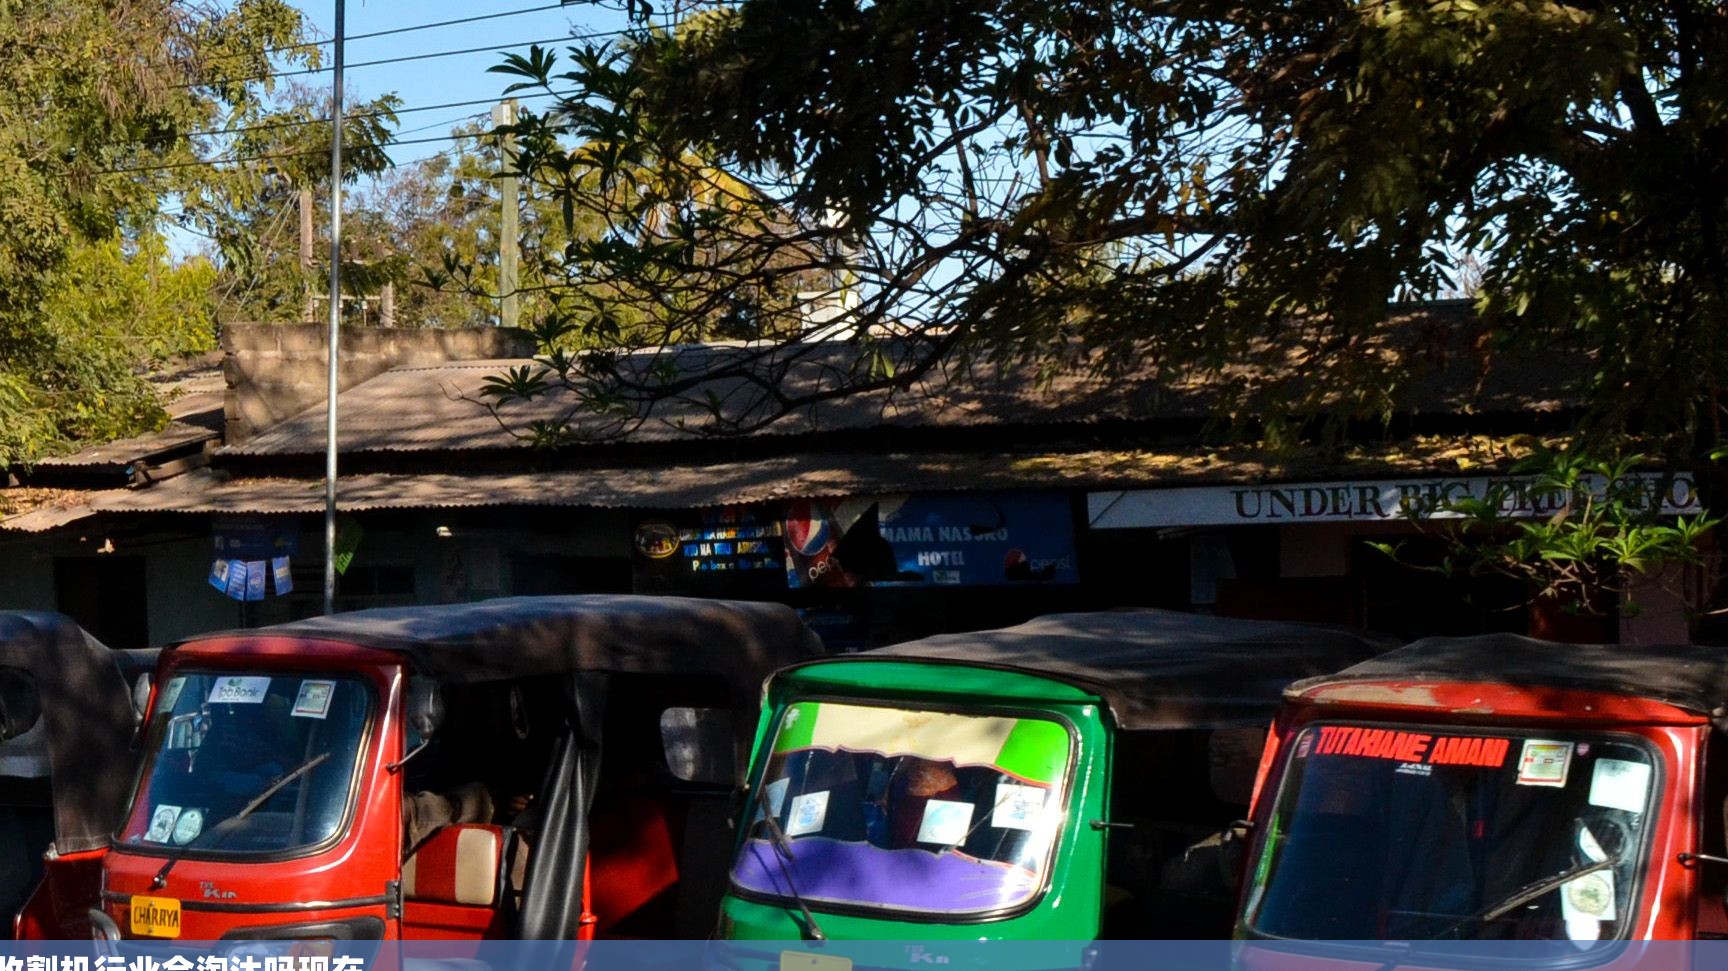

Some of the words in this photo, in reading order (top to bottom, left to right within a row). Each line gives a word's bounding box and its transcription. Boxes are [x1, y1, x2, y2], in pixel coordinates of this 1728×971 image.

[1231, 485, 1390, 519] UNDER
[1609, 476, 1702, 510] SHO
[918, 551, 965, 566] HOTEL
[1428, 737, 1510, 767] AMANI
